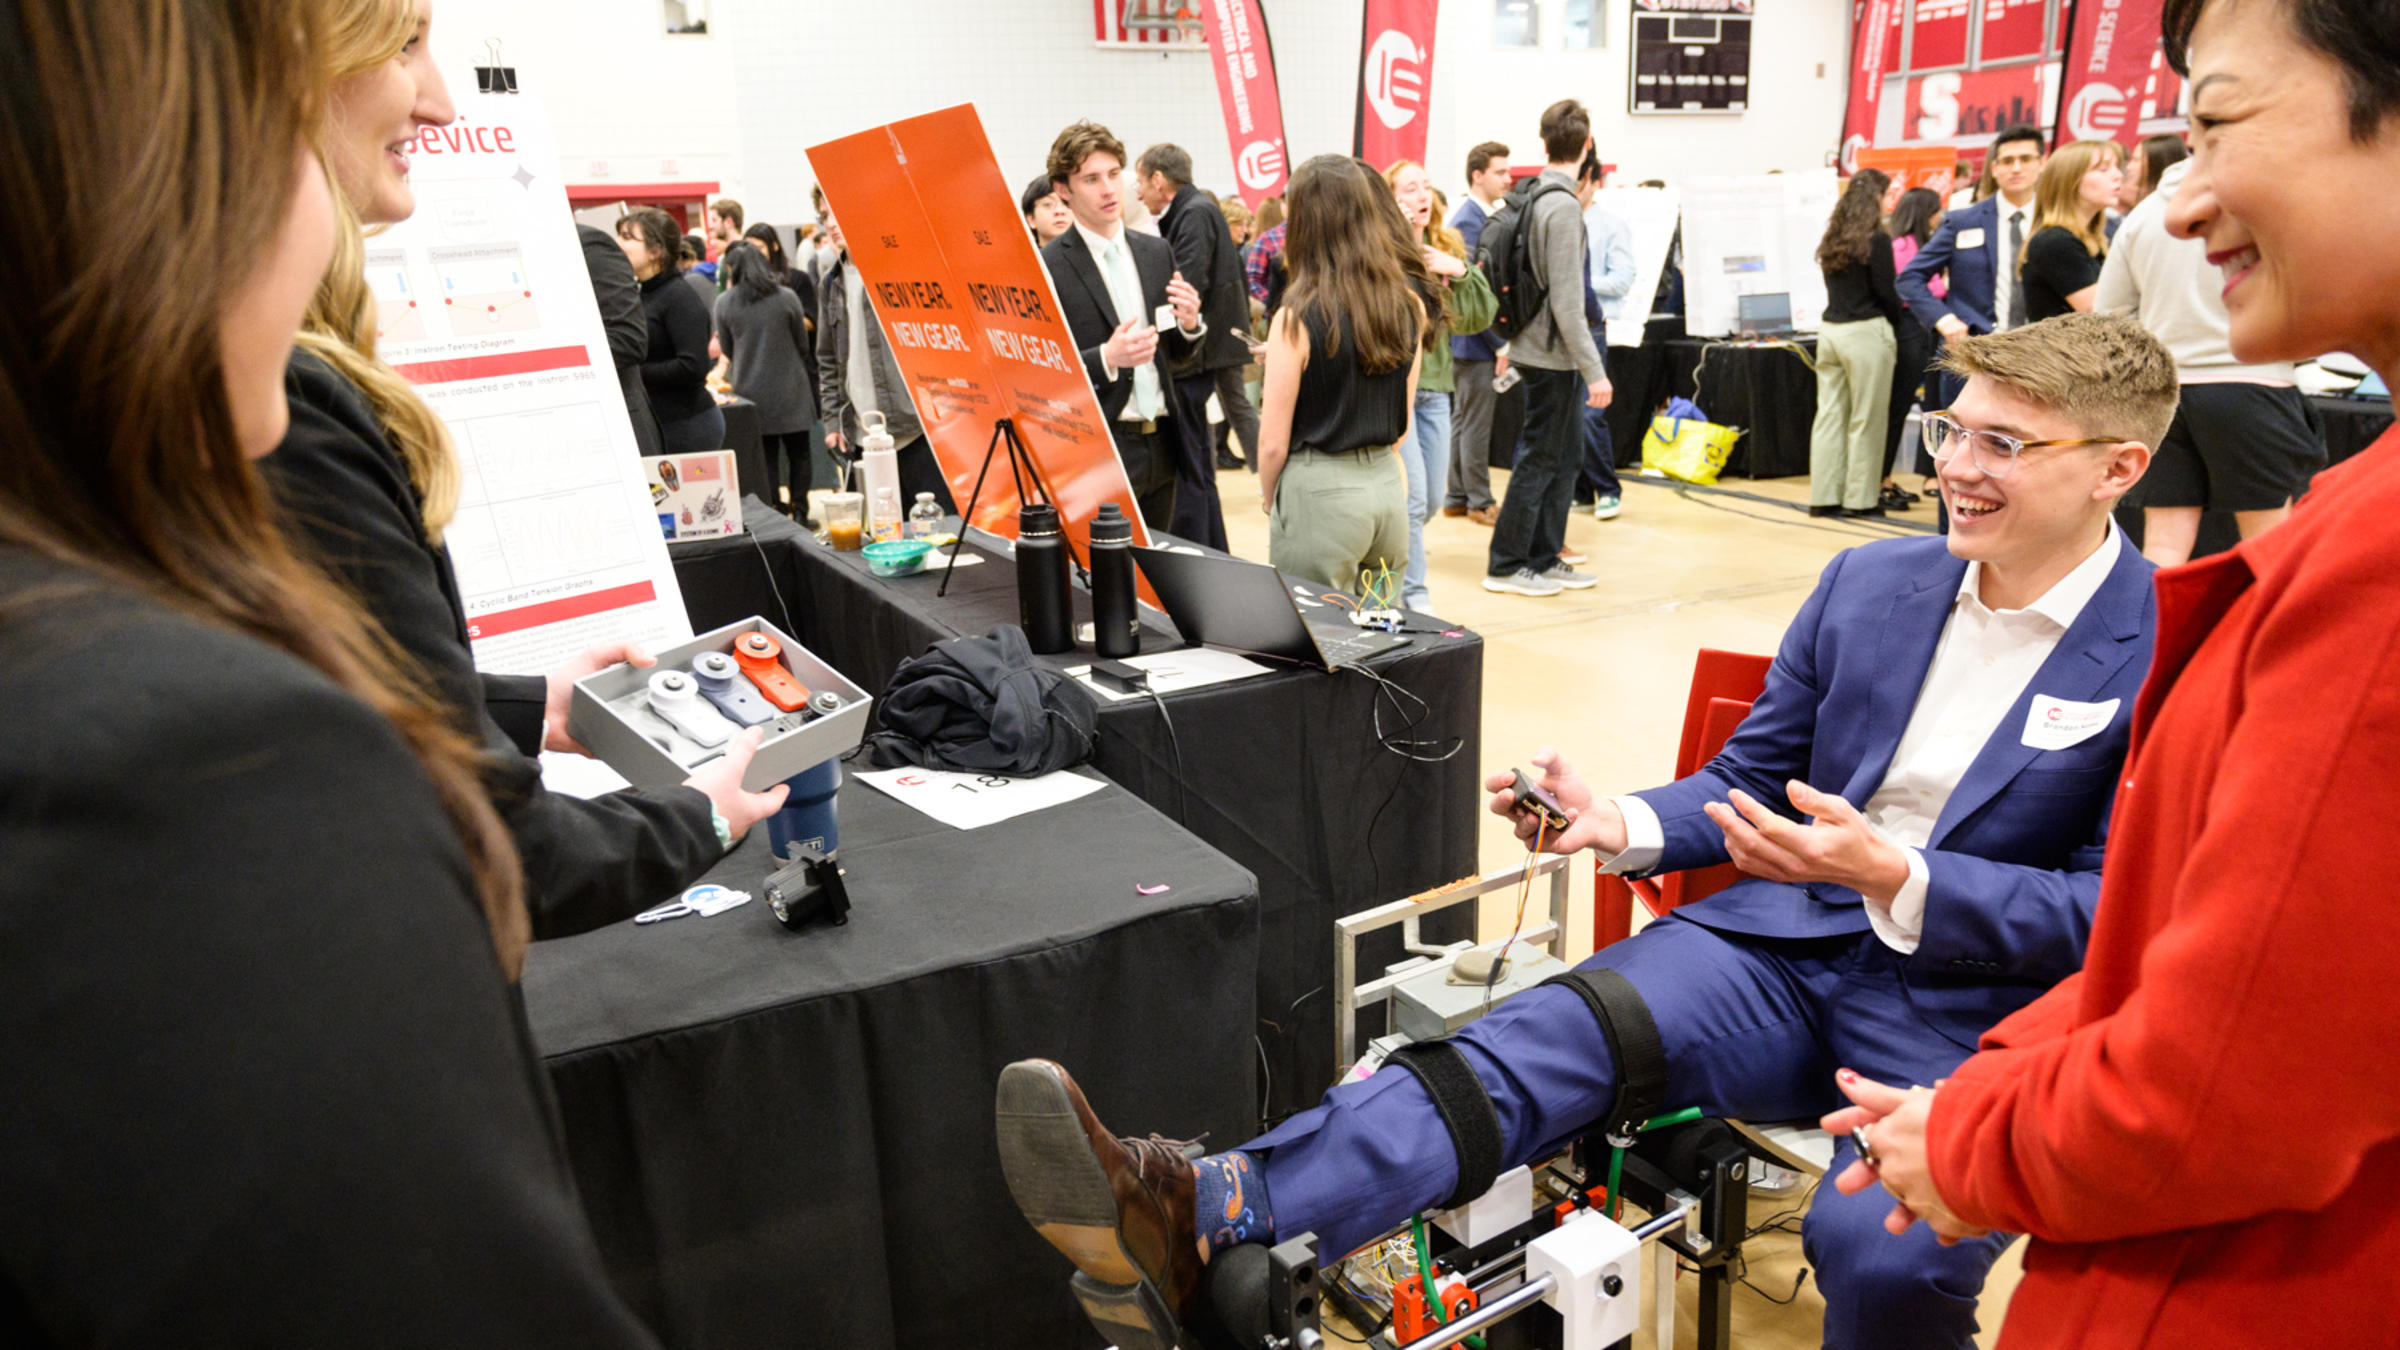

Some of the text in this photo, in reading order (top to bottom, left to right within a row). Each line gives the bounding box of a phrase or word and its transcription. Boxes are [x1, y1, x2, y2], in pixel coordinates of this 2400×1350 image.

[2088, 11, 2118, 72] SCIENCE
[1241, 52, 1258, 79] AND
[1226, 53, 1254, 134] ENGINEERING
[408, 115, 516, 154] evice
[875, 282, 953, 310] NEW YEAR.
[967, 282, 1052, 323] NEW YEAR.
[891, 321, 971, 352] NEW GEAR.
[985, 328, 1073, 374] NEW GEAR.
